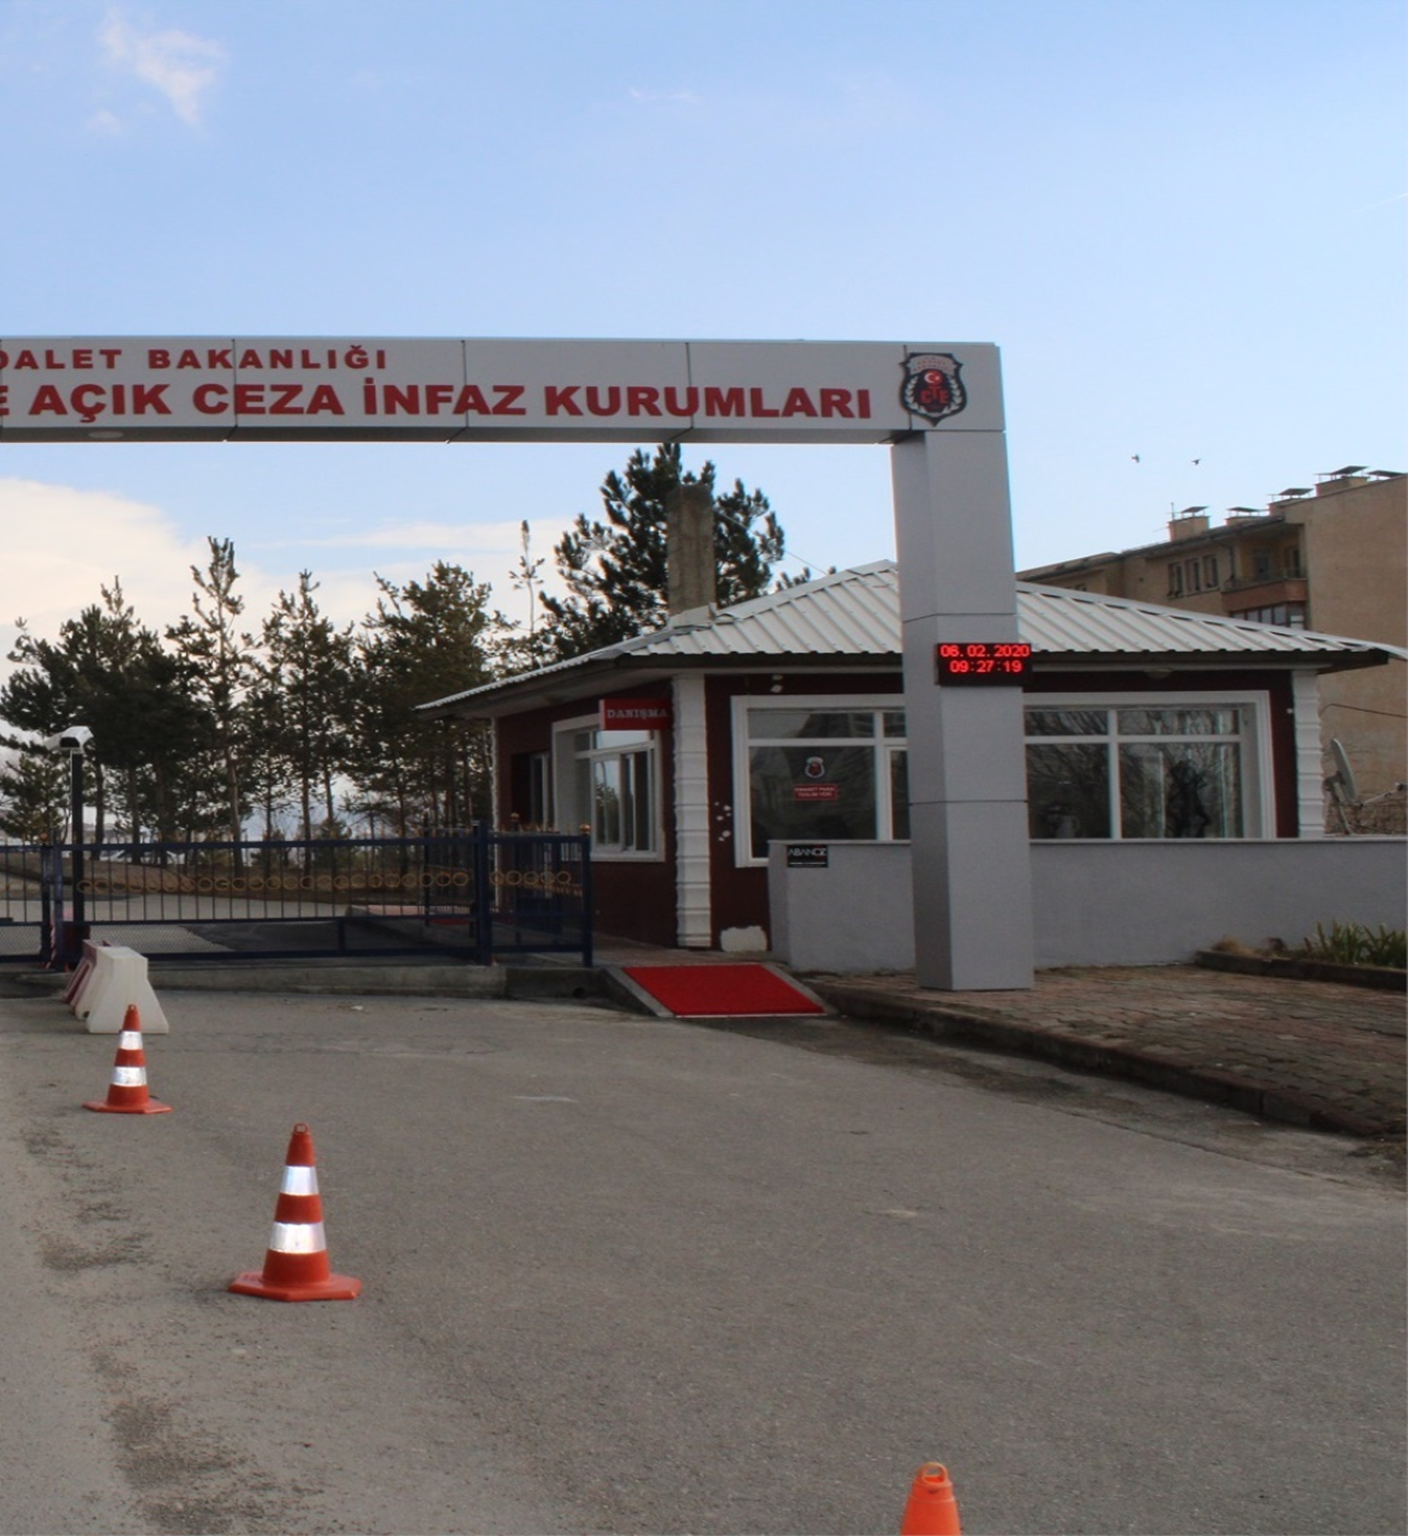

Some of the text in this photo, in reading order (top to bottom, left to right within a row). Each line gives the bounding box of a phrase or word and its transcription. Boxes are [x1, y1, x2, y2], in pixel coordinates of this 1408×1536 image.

[148, 346, 386, 371] BAKANLIĞI
[29, 383, 171, 424] AÇIK
[192, 383, 345, 416] CEZA
[363, 377, 527, 416] İNFAZ
[544, 385, 870, 419] KURUMLARI
[949, 660, 1023, 673] 09:27:19
[607, 708, 668, 720] DANIŞMA
